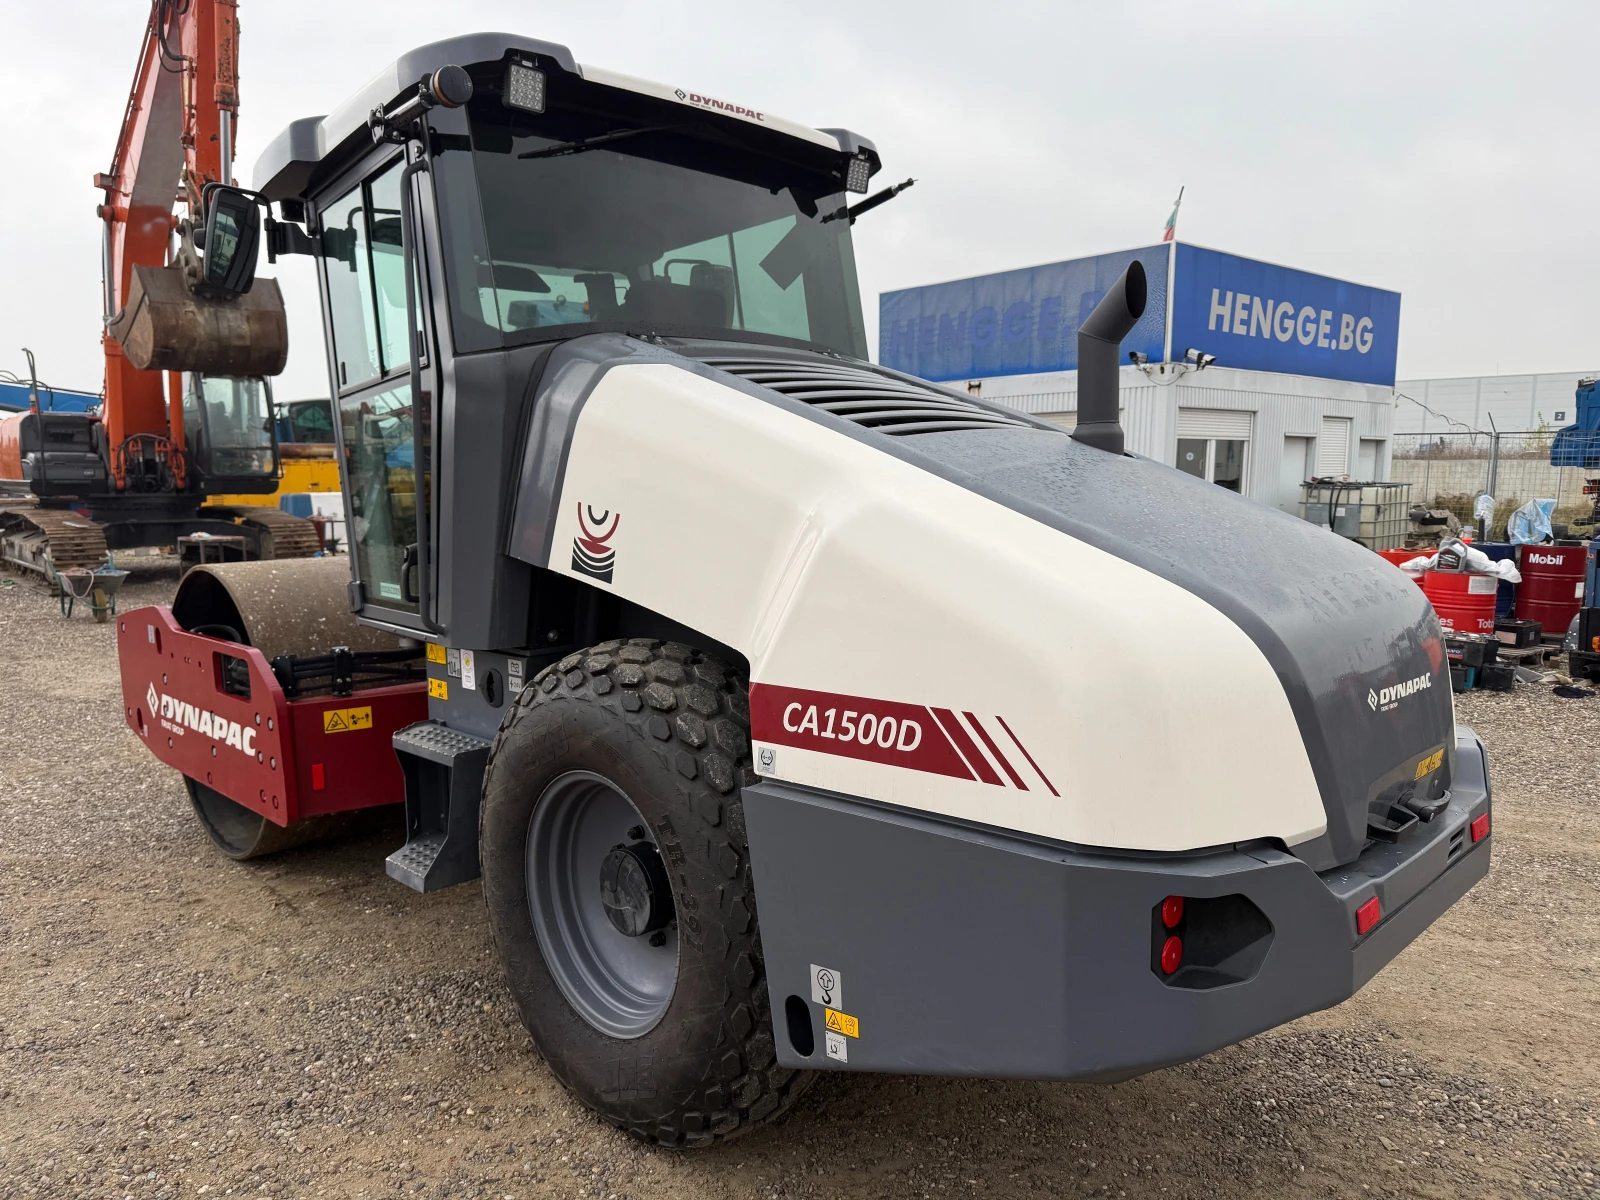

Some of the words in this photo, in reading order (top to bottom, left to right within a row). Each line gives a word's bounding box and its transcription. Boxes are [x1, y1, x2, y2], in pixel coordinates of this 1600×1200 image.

[689, 93, 765, 122] DYNAPAC
[1208, 288, 1374, 354] HENGGE.BG
[1529, 553, 1563, 566] Mobil
[1379, 672, 1432, 705] DYNAPAC
[160, 693, 257, 757] DYNAPAC
[782, 702, 923, 752] CA1500D
[657, 813, 704, 956] TR-391
